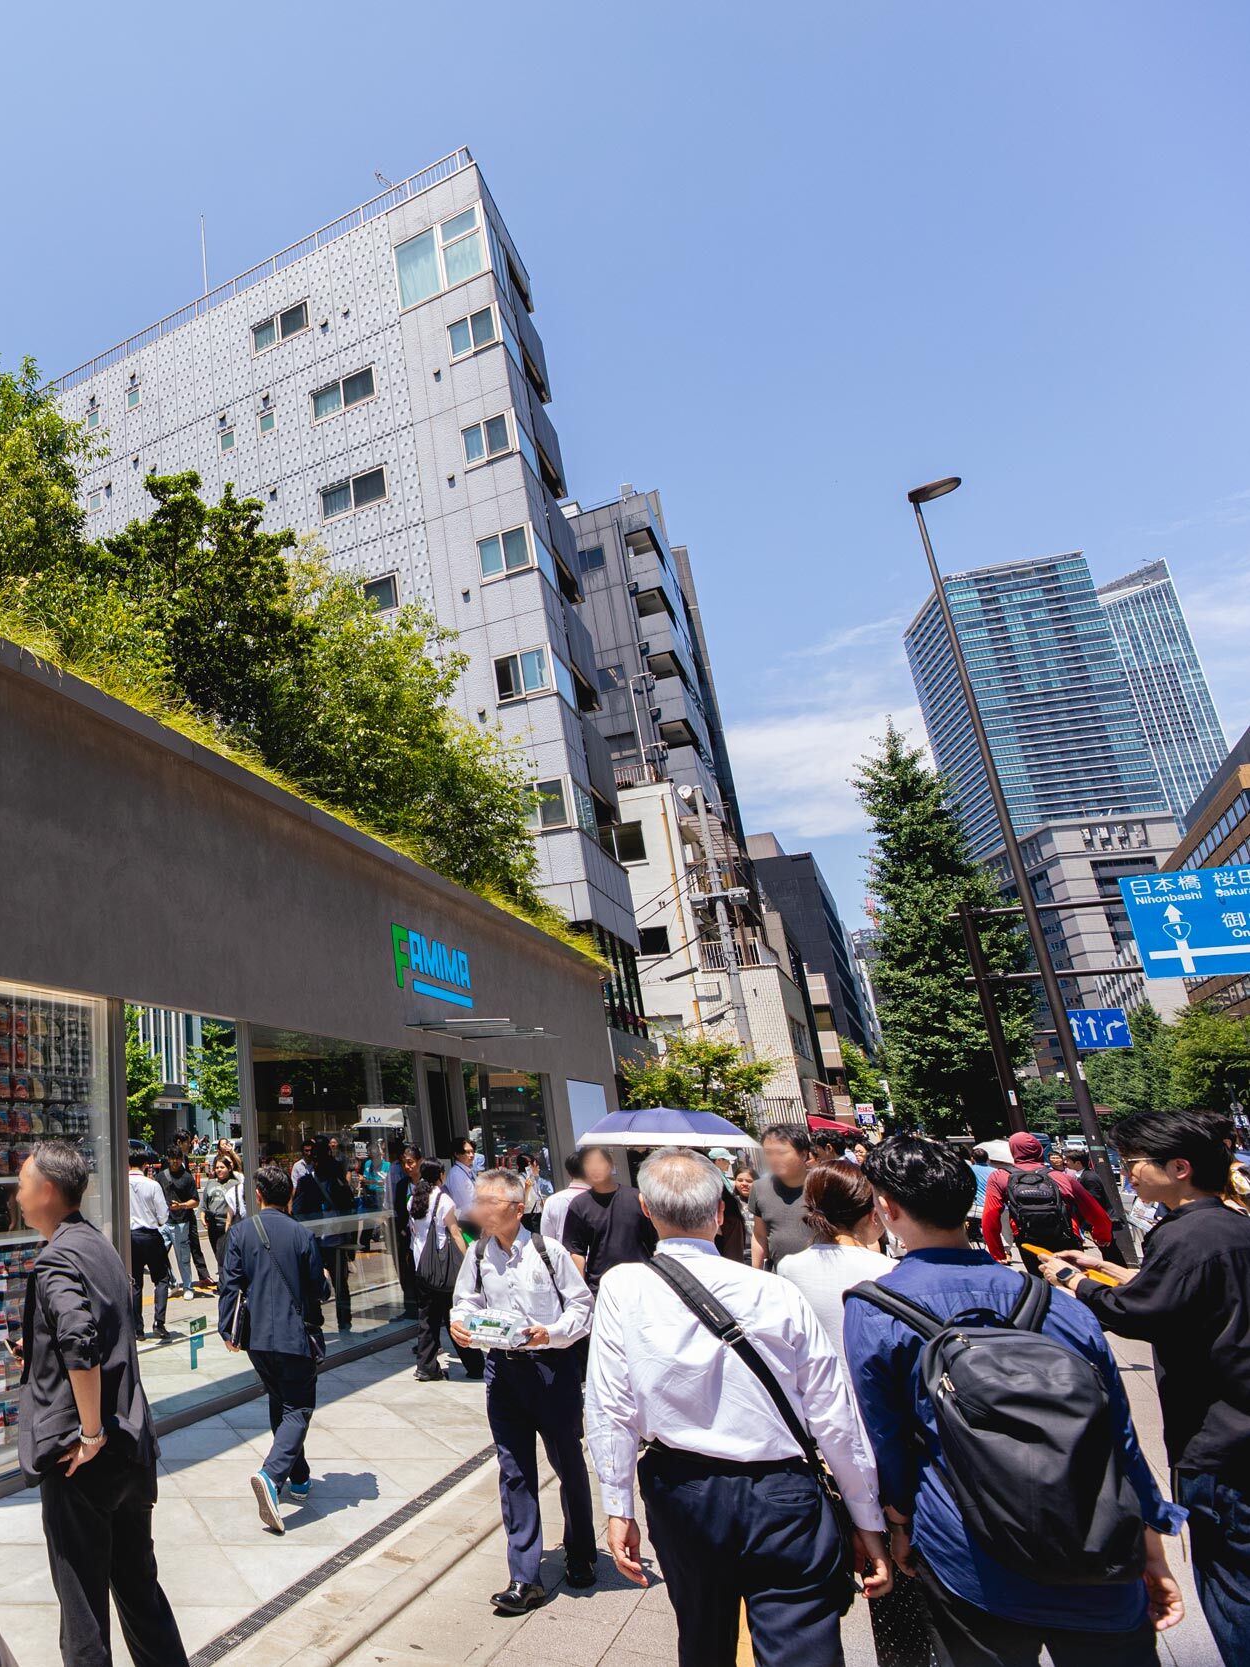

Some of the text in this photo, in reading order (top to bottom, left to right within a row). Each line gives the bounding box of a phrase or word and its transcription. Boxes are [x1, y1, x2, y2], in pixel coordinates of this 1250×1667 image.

[1131, 875, 1201, 895] 日本橋
[1135, 891, 1202, 904] Nihonbashi
[1173, 924, 1182, 936] 1
[391, 923, 470, 989] FAMIMA
